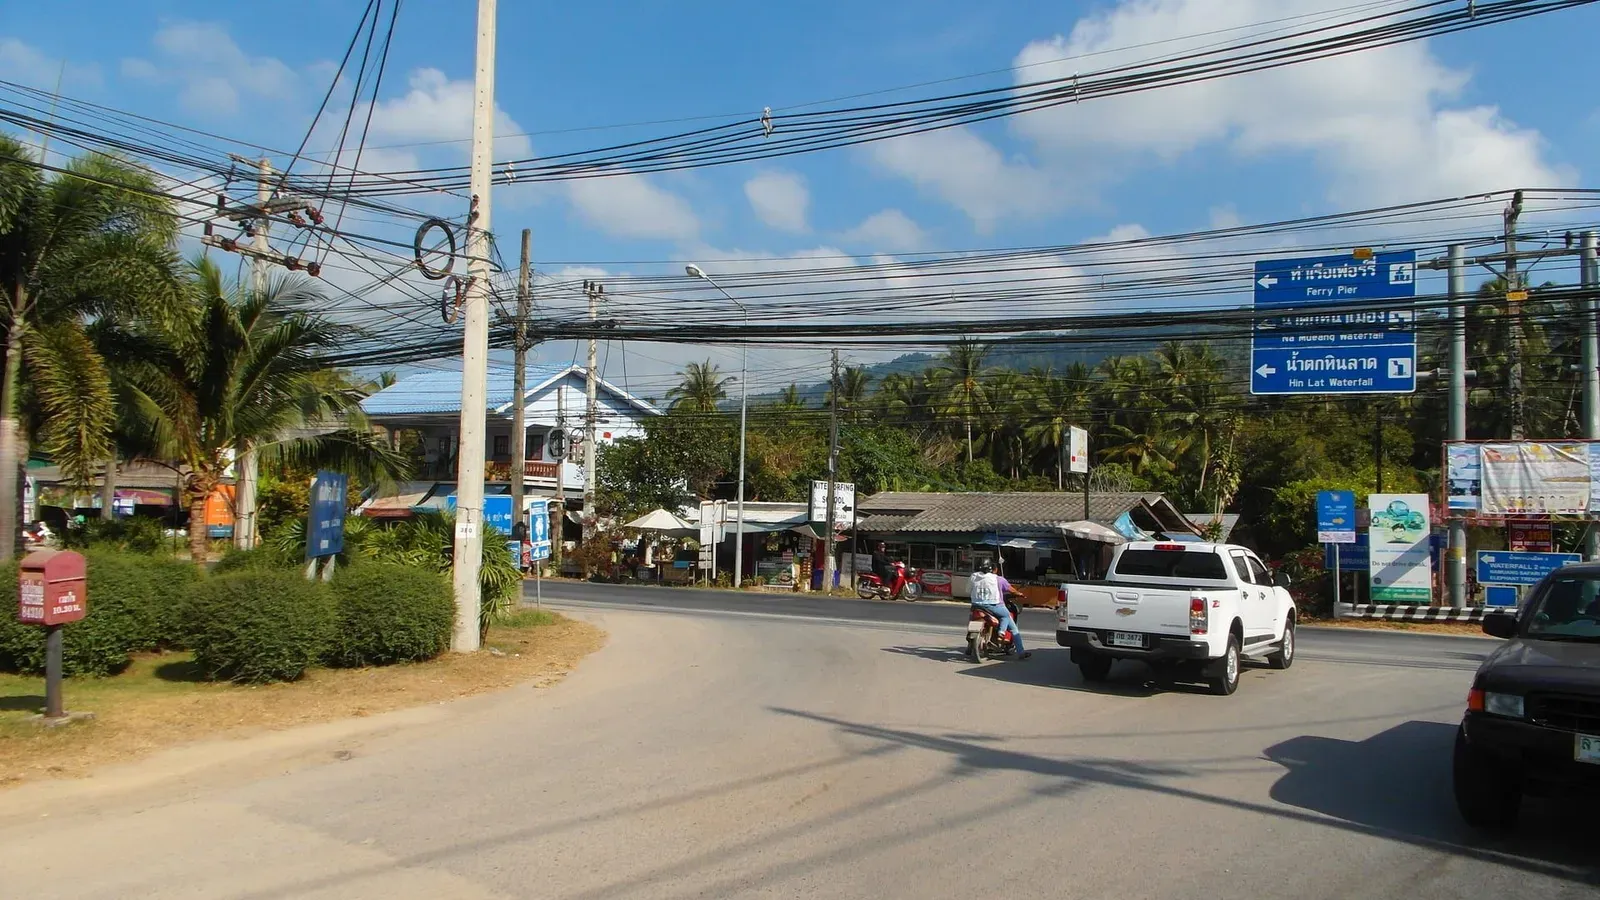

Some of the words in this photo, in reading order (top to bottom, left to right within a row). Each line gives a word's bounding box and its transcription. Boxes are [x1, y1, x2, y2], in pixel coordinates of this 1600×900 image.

[1306, 287, 1333, 297] Ferry
[1337, 285, 1358, 295] Pier
[1286, 350, 1378, 372] น้ำตกหินลาด
[1288, 378, 1304, 388] Hin
[1307, 378, 1325, 387] Lat
[1329, 377, 1374, 387] Waterfall
[813, 481, 853, 491] KITERFING
[821, 495, 845, 504] SOOL
